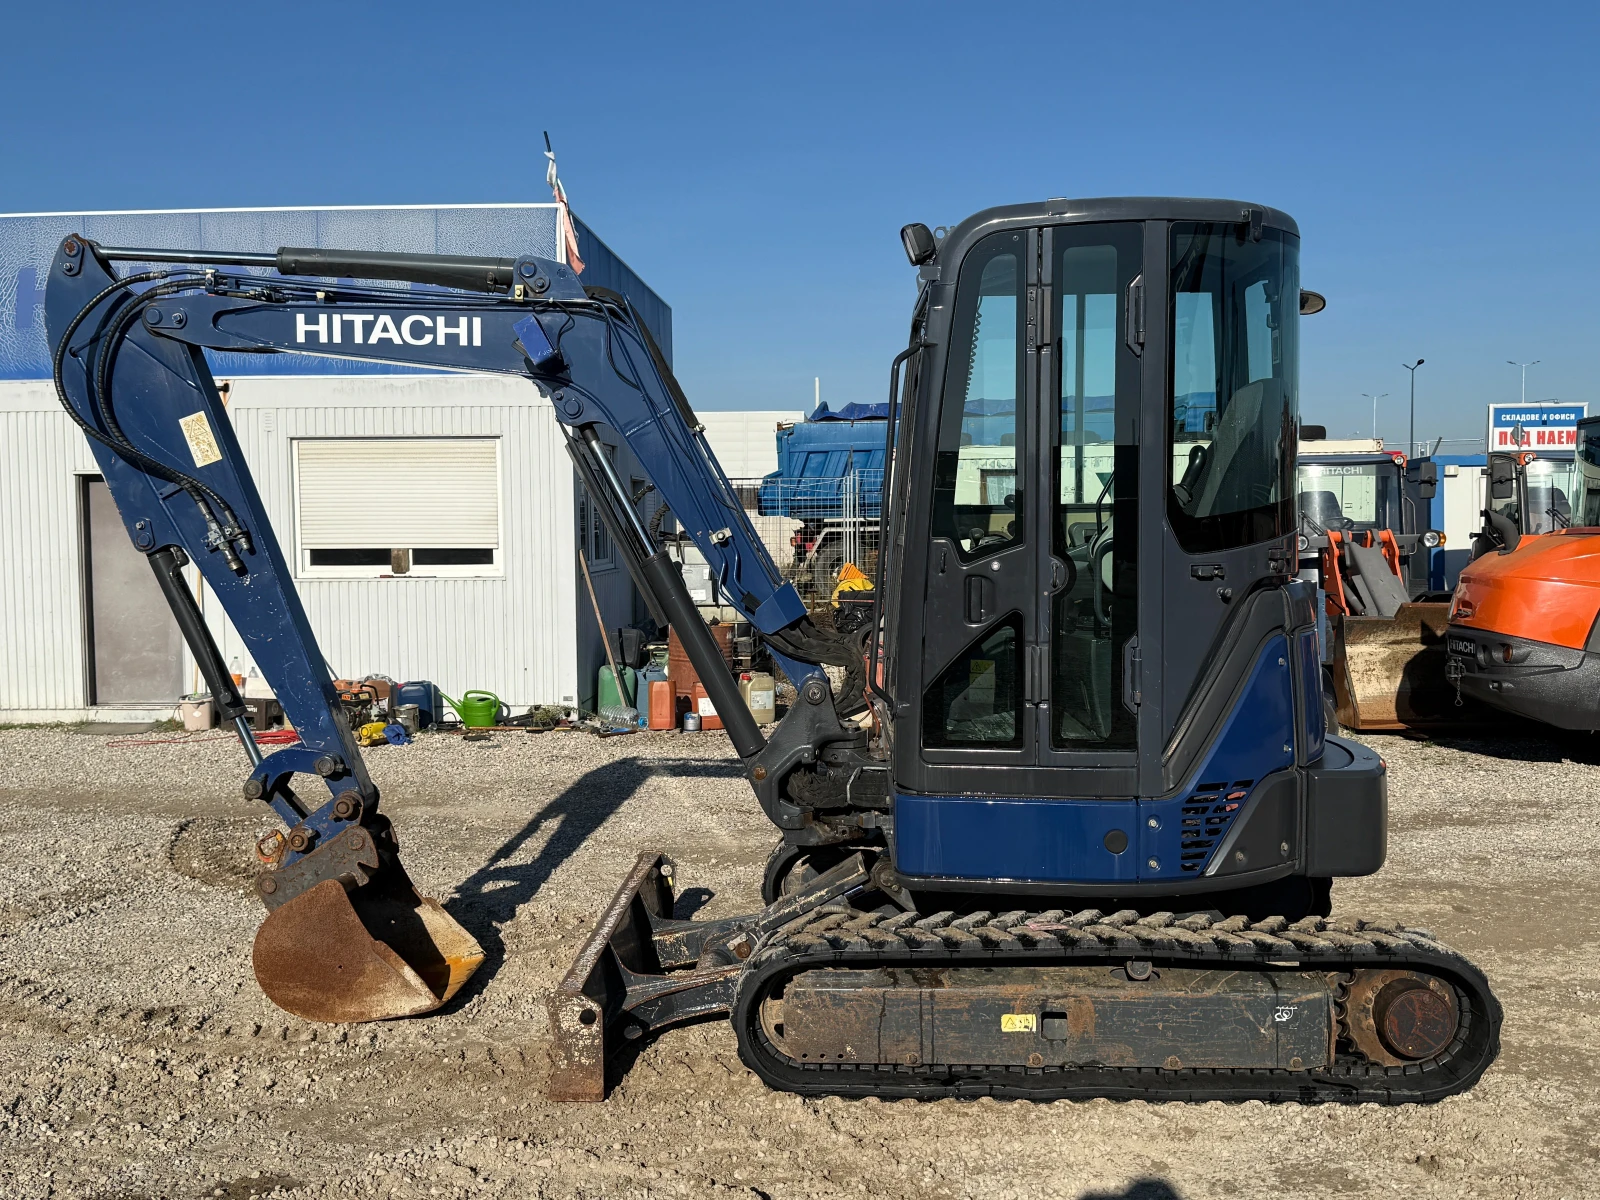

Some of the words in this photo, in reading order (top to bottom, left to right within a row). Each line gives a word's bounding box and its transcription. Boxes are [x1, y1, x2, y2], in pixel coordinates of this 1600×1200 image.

[296, 313, 481, 346] HITACHI
[1501, 413, 1540, 421] СКЛАДОВЕ
[1536, 430, 1577, 445] НАЕМ
[1449, 639, 1476, 654] HITACHI
